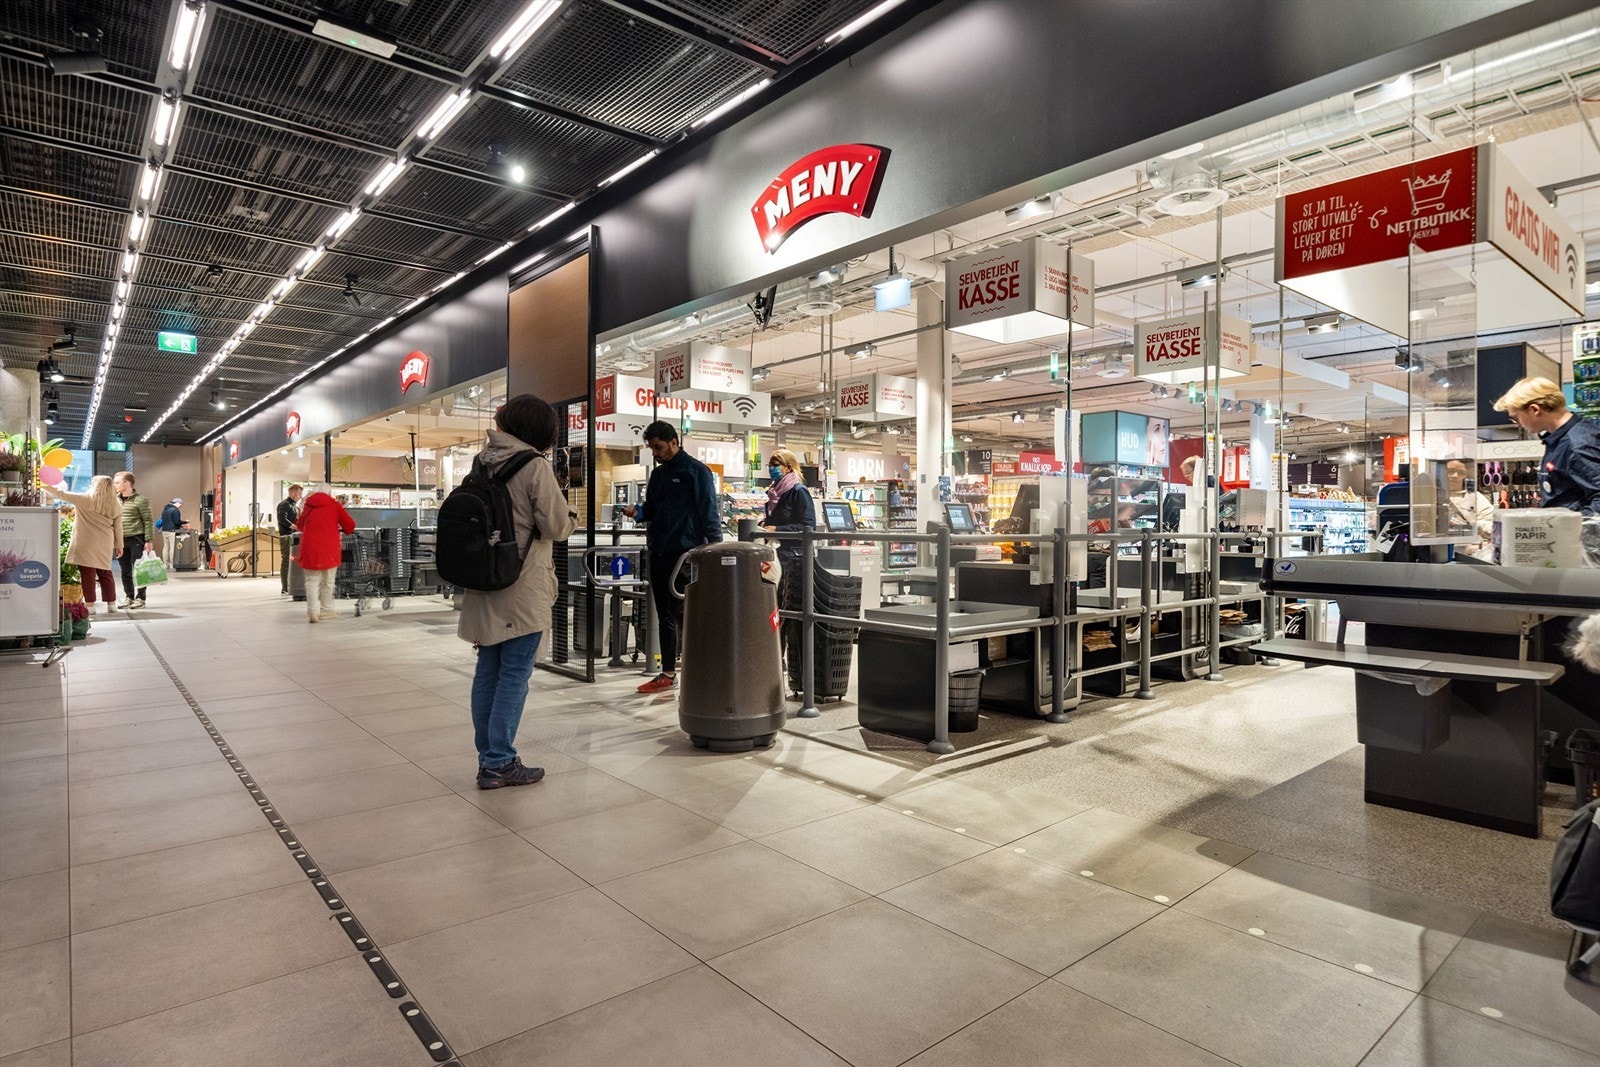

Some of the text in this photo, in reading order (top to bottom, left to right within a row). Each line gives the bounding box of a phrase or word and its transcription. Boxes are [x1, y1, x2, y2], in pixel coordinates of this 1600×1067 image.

[763, 161, 863, 231] MENY
[1303, 196, 1346, 217] SI JA TIL
[1292, 208, 1357, 235] STORT UTVALG
[1386, 207, 1471, 236] NETTBUTIKK
[1505, 186, 1560, 274] GRATIS WIFI
[1294, 224, 1354, 249] LEVERT RETT
[1302, 242, 1345, 262] PÅ DØREN
[959, 260, 1020, 286] SELVBETJENT
[958, 274, 1020, 310] KASSE
[1146, 327, 1201, 344] SELVBETJENT
[1146, 338, 1201, 362] KASSE
[635, 388, 688, 411] GRATIS
[841, 384, 869, 395] SELVBETJENT
[841, 392, 869, 408] KASSE
[1121, 432, 1139, 449] HUD
[1493, 445, 1539, 455] basic
[982, 451, 991, 460] 10
[847, 458, 885, 478] BARN
